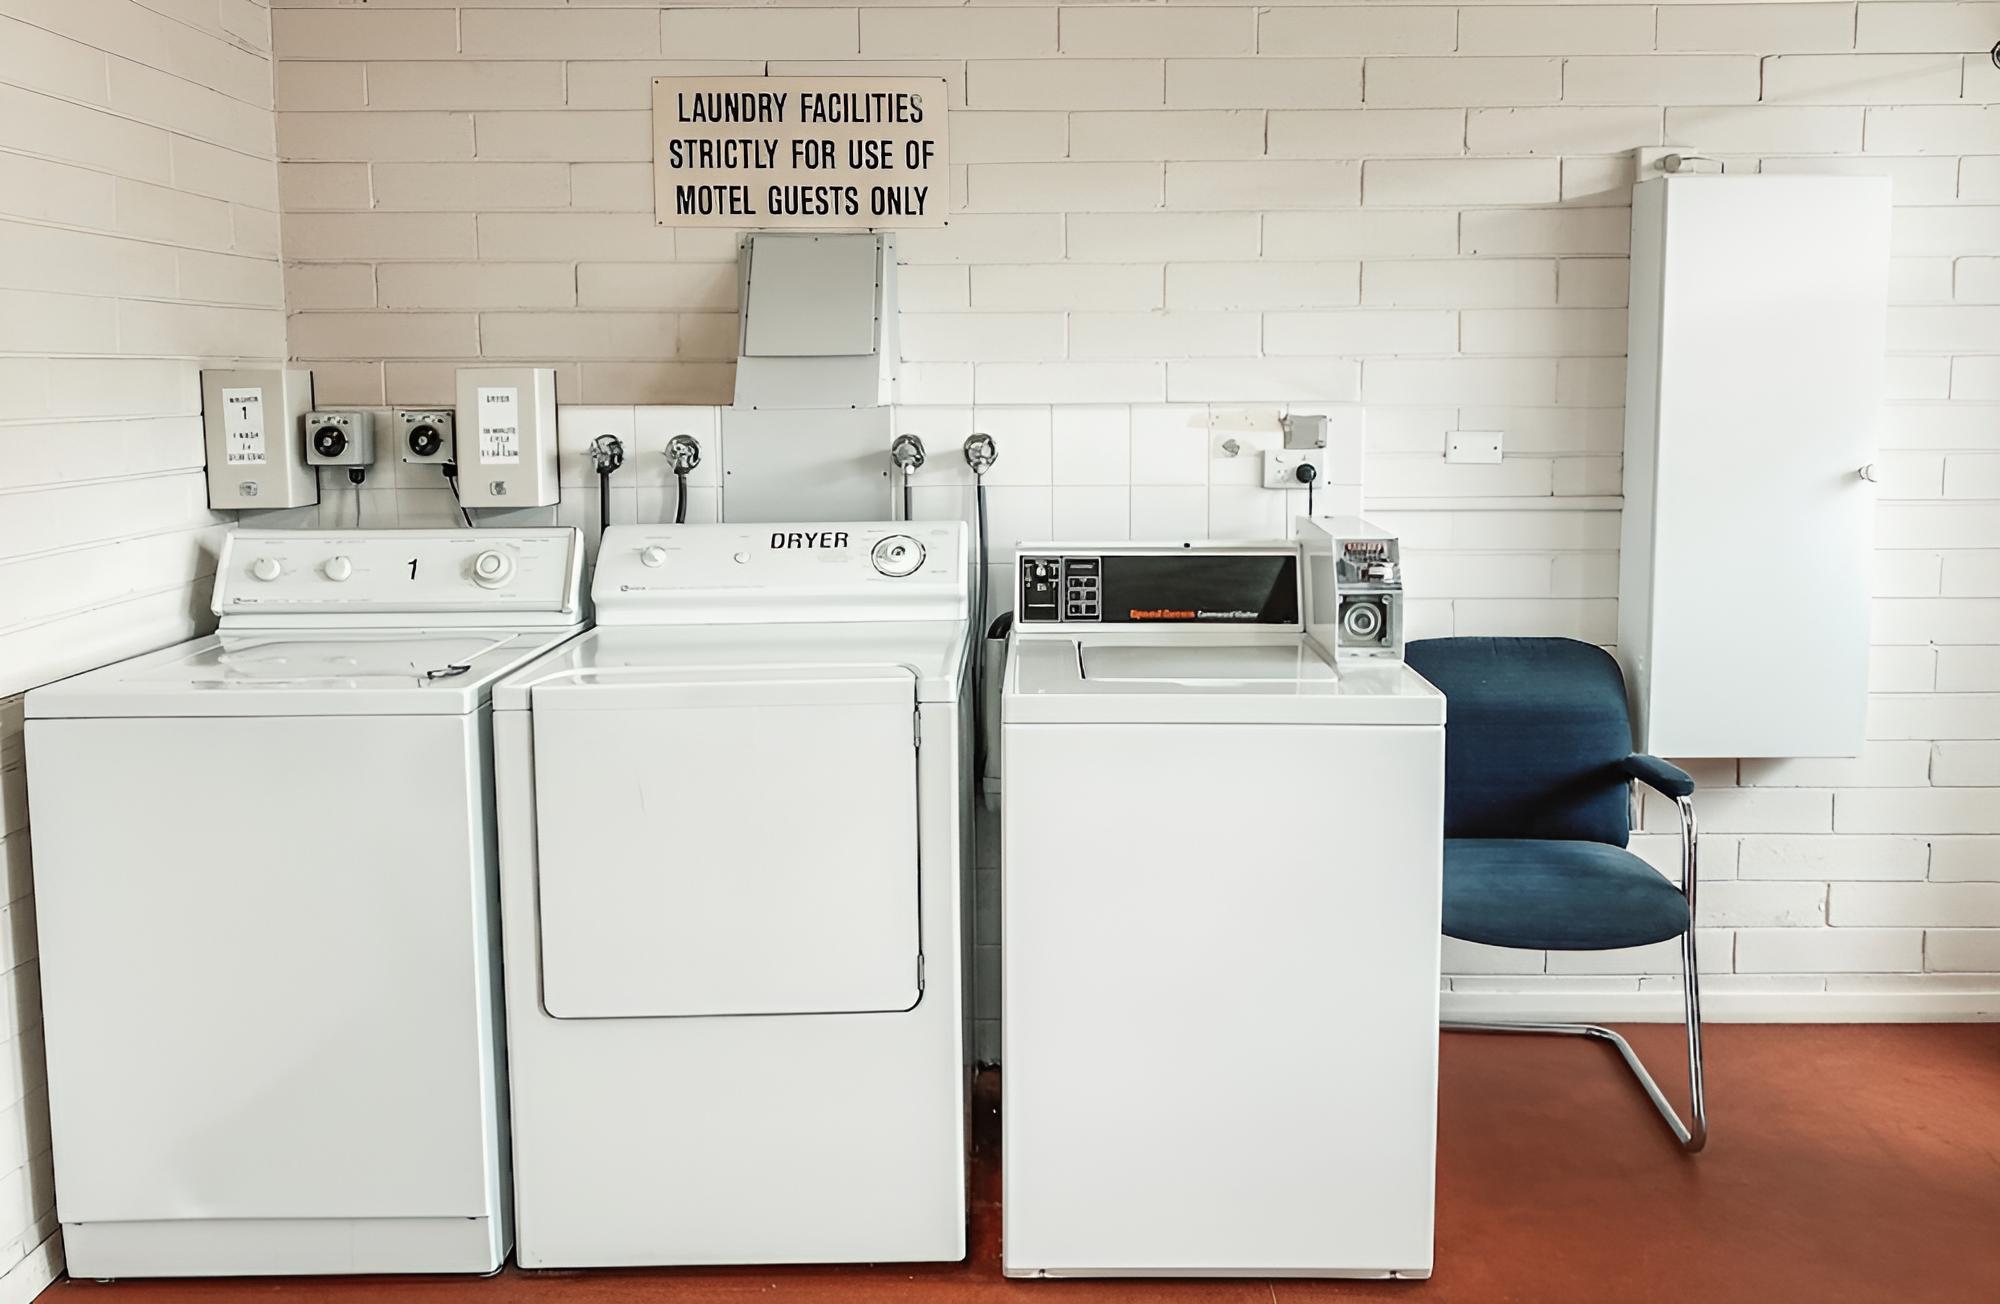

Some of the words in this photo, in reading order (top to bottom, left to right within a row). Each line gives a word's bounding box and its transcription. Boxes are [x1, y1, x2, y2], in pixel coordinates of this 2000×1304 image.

[678, 93, 787, 122] LAUNDRY
[800, 93, 923, 123] FACILITIES
[669, 139, 778, 169] STRICTLY
[792, 140, 835, 169] FOR
[849, 140, 893, 170] USE
[906, 140, 934, 169] OF
[676, 185, 756, 215] MOTEL
[768, 186, 858, 215] GUESTS
[871, 186, 928, 215] ONLY
[242, 406, 247, 420] 1
[770, 532, 849, 549] DRYER
[408, 558, 418, 580] 1
